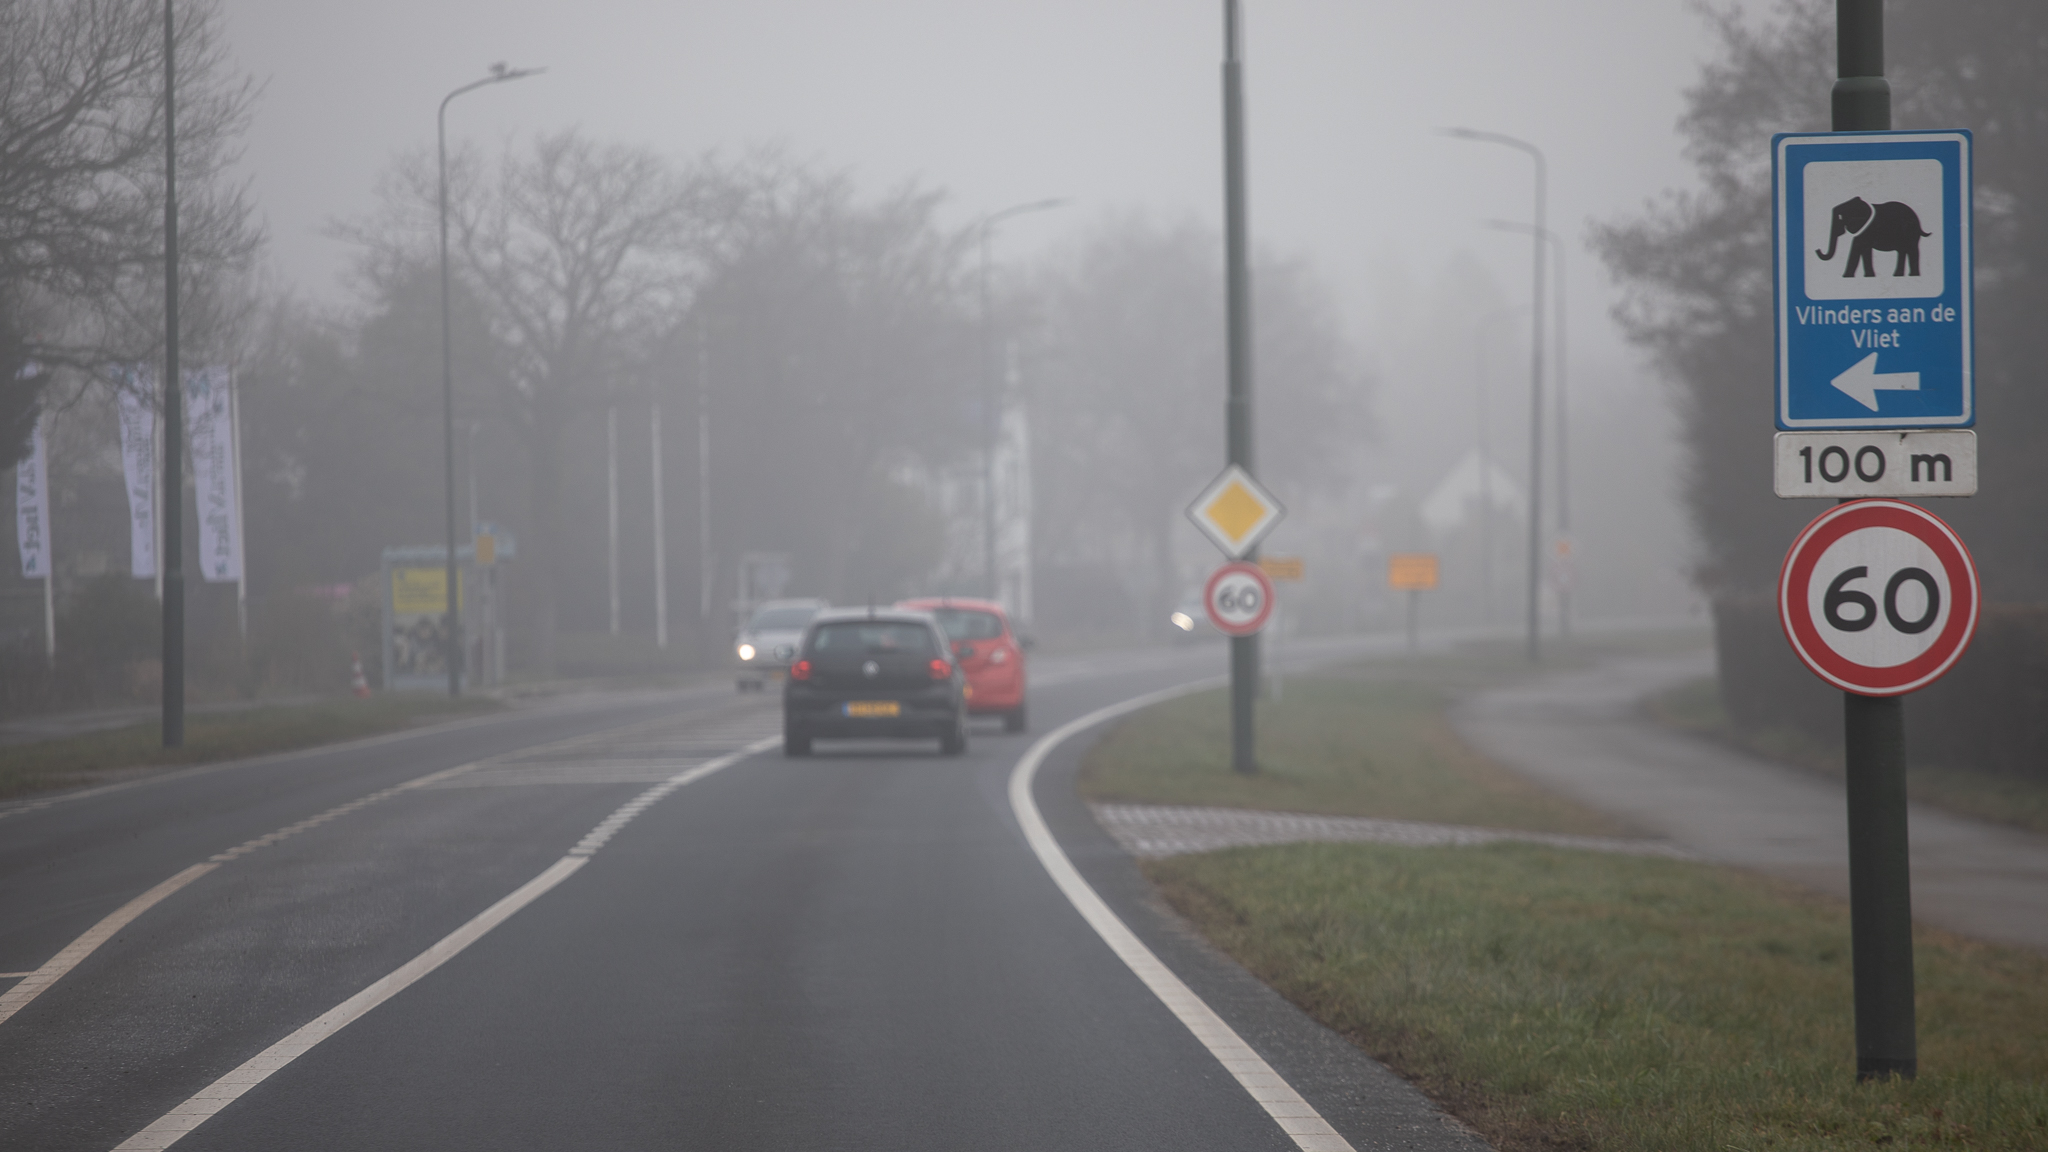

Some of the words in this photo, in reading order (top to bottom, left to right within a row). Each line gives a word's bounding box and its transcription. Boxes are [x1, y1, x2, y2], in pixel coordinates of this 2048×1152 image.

[1795, 304, 1882, 325] Vlinders
[1886, 307, 1925, 323] aan
[1931, 303, 1956, 322] de
[1851, 328, 1900, 348] Vliet
[1799, 445, 1886, 483] 100
[1911, 453, 1952, 482] m
[1218, 584, 1261, 615] 60
[1823, 565, 1940, 634] 60
